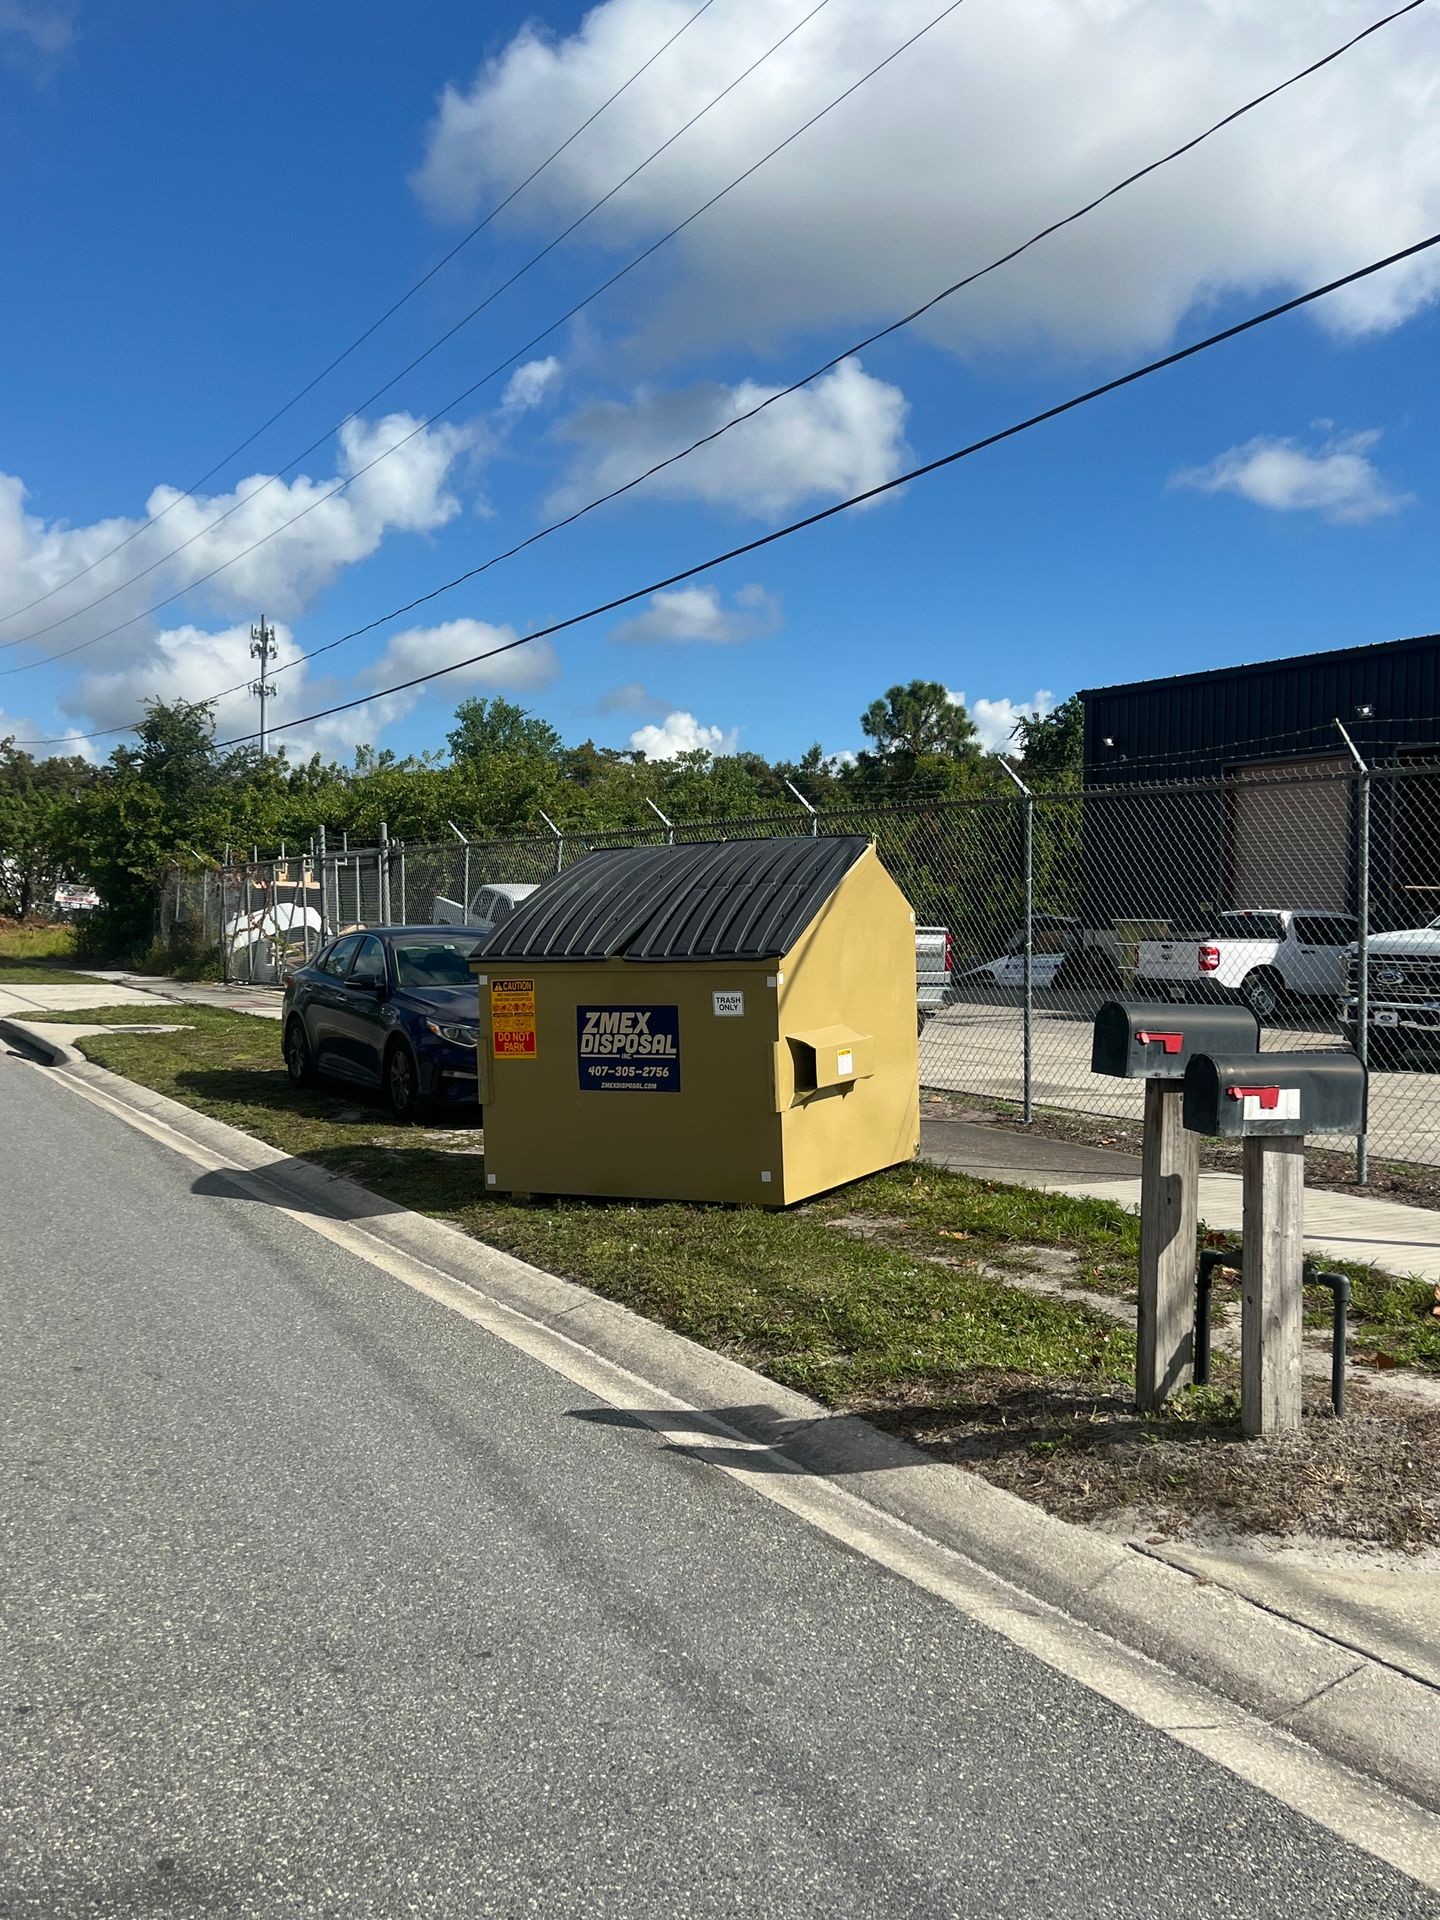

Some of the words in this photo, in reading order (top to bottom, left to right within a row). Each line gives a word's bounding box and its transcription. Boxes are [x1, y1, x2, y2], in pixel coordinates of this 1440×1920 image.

[503, 982, 532, 991] CAUTION
[583, 1012, 651, 1034] ZMEX
[498, 1032, 510, 1041] DO
[512, 1032, 531, 1041] NOT
[504, 1042, 526, 1052] PARK
[580, 1034, 677, 1054] DISPOSAL
[587, 1066, 669, 1077] 407-305-2756
